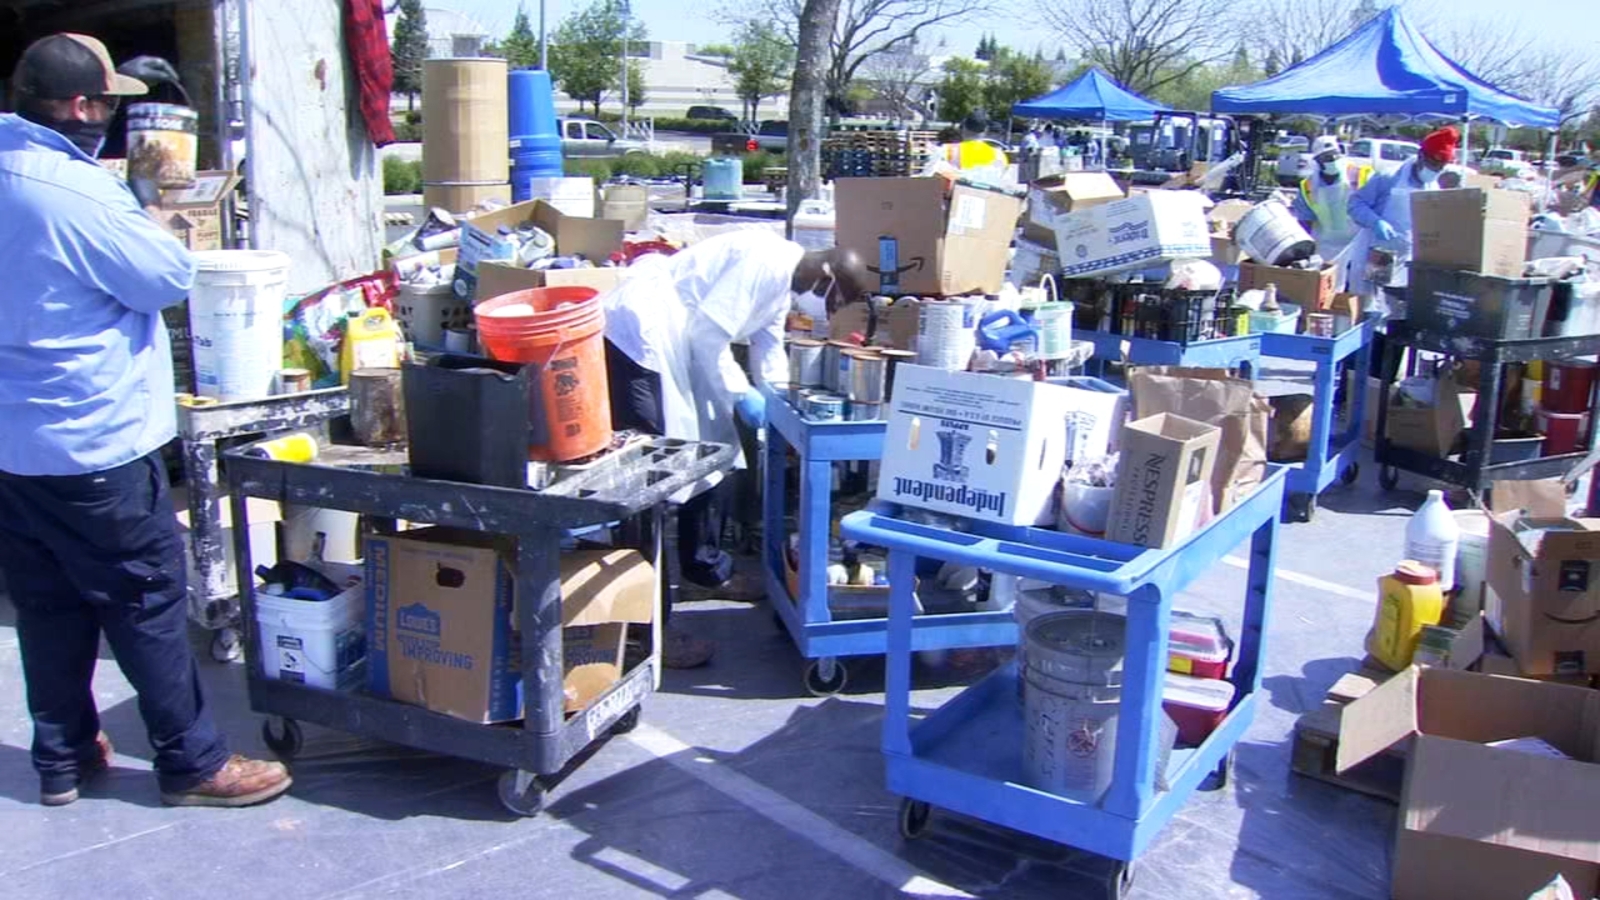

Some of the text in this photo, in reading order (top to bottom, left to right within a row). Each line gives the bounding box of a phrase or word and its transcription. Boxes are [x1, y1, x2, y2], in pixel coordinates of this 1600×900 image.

[893, 476, 1006, 518] Independent
[374, 546, 387, 651] MEDIUM
[401, 642, 474, 670] IMPROVING
